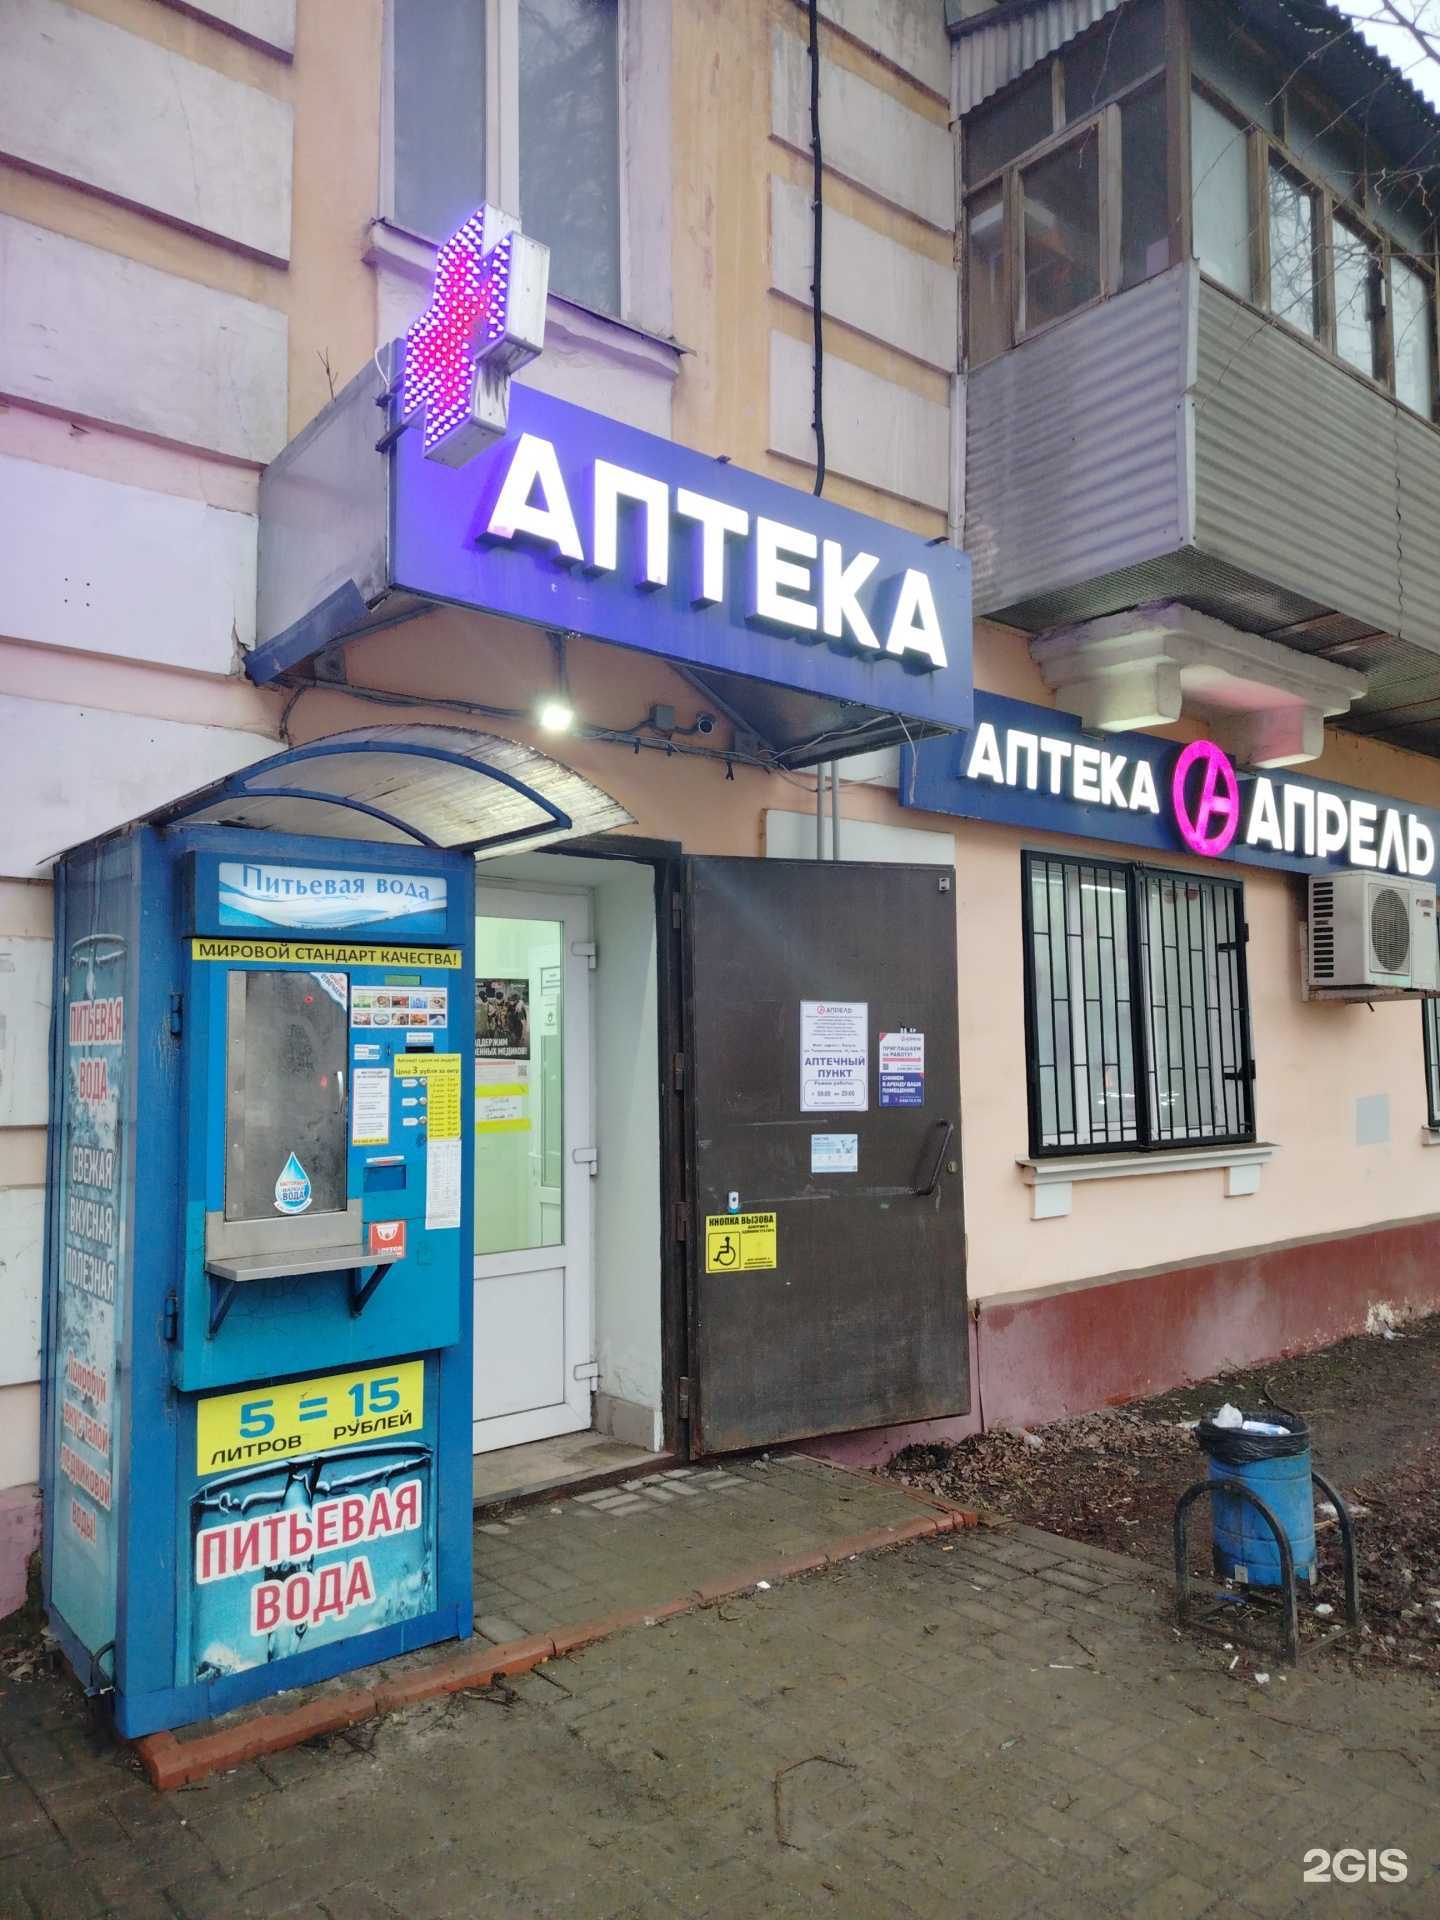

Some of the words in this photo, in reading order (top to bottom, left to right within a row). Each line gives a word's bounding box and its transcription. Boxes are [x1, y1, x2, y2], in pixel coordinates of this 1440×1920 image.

[487, 433, 948, 668] АПТЕКА
[967, 722, 1160, 815] АПТЕКА
[1246, 778, 1436, 877] АПРЕЛЬ
[241, 863, 365, 896] Питьевая
[376, 878, 431, 902] вода
[199, 943, 290, 960] МИРОВОЙ
[295, 946, 377, 964] СТАНДАРТ
[381, 951, 458, 966] КАЧЕСТВА!
[70, 1000, 122, 1042] ПИТЬЕВАЯ
[79, 1059, 108, 1104] ВОДА
[412, 1065, 418, 1074] 3
[805, 1056, 865, 1066] АПТЕЧНЫЙ
[817, 1069, 853, 1079] ПУНКТ
[72, 1146, 113, 1190] СВЕЖАЯ
[282, 1191, 304, 1201] ВОДА
[70, 1196, 113, 1246] ВКУСНАЯ
[709, 1217, 739, 1227] КНОПКА
[741, 1215, 774, 1225] ВЫЗОВА
[66, 1247, 114, 1301] ПОЛЕЗНАЯ
[68, 1350, 106, 1405] Попробуй
[64, 1403, 83, 1438] вкус
[84, 1416, 109, 1454] талой
[239, 1400, 276, 1438] 5
[347, 1377, 400, 1417] 15
[210, 1435, 302, 1465] ЛИТРОВ
[333, 1410, 412, 1440] РУБЛЕЙ
[62, 1445, 111, 1506] ледниковой
[72, 1502, 96, 1542] воды!
[202, 1484, 418, 1579] ПИТЬЕВАЯ
[256, 1560, 372, 1631] ВОДА
